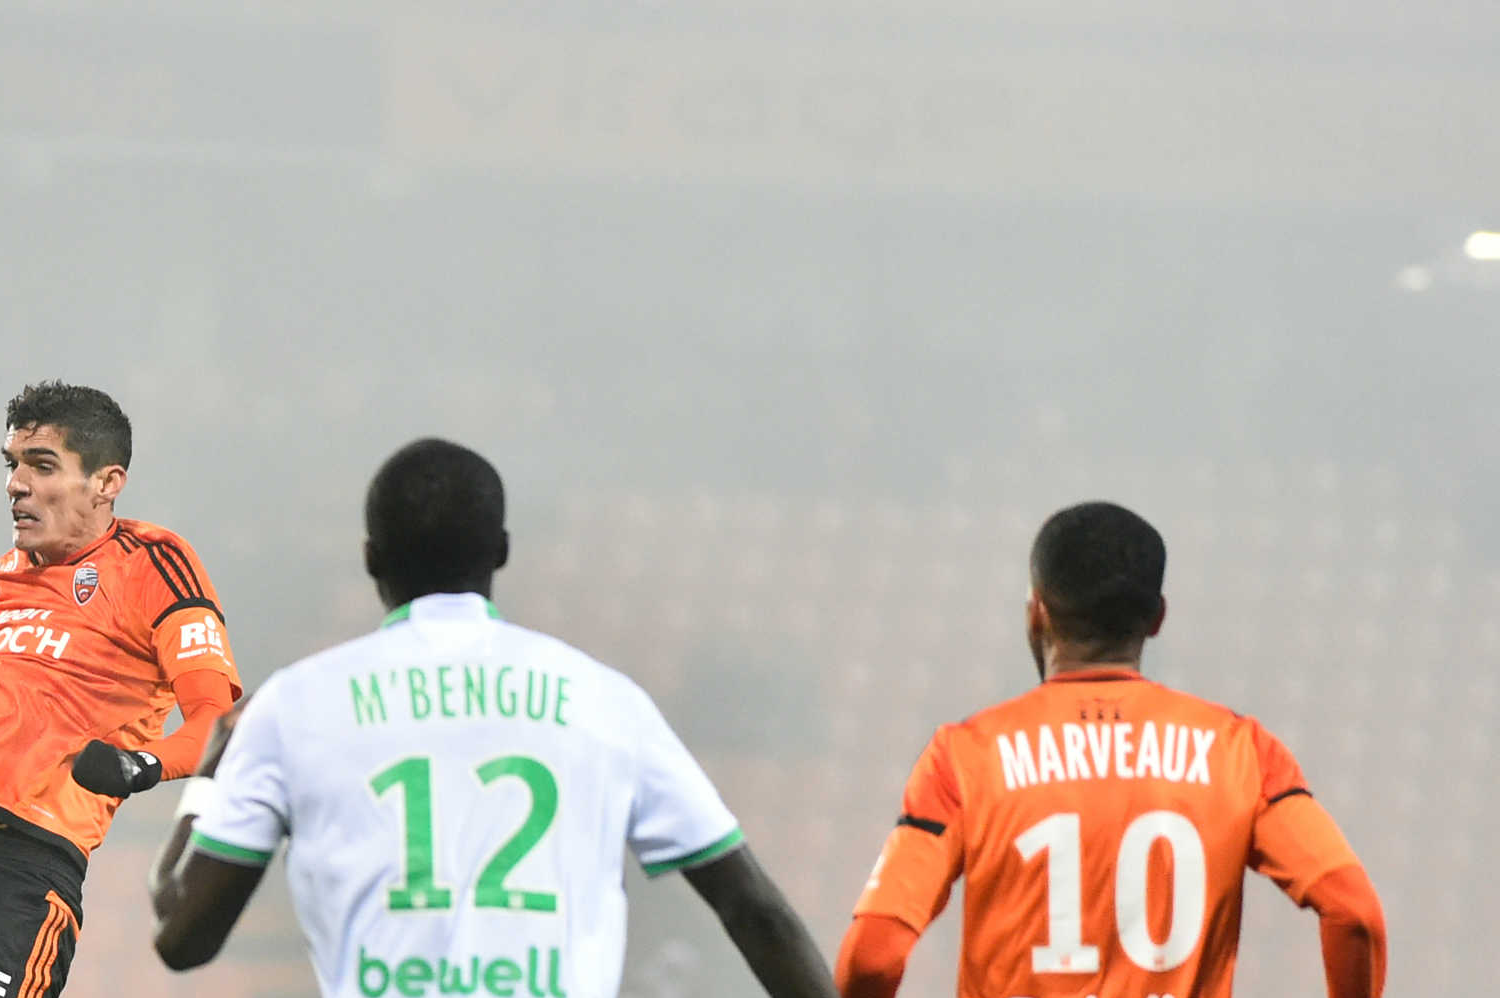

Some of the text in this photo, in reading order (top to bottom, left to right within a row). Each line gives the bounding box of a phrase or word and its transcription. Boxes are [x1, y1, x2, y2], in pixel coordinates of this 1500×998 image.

[349, 664, 571, 727] M'BENGUE
[997, 720, 1215, 791] MARVEAUX
[367, 754, 560, 914] 12
[1014, 809, 1207, 974] 10
